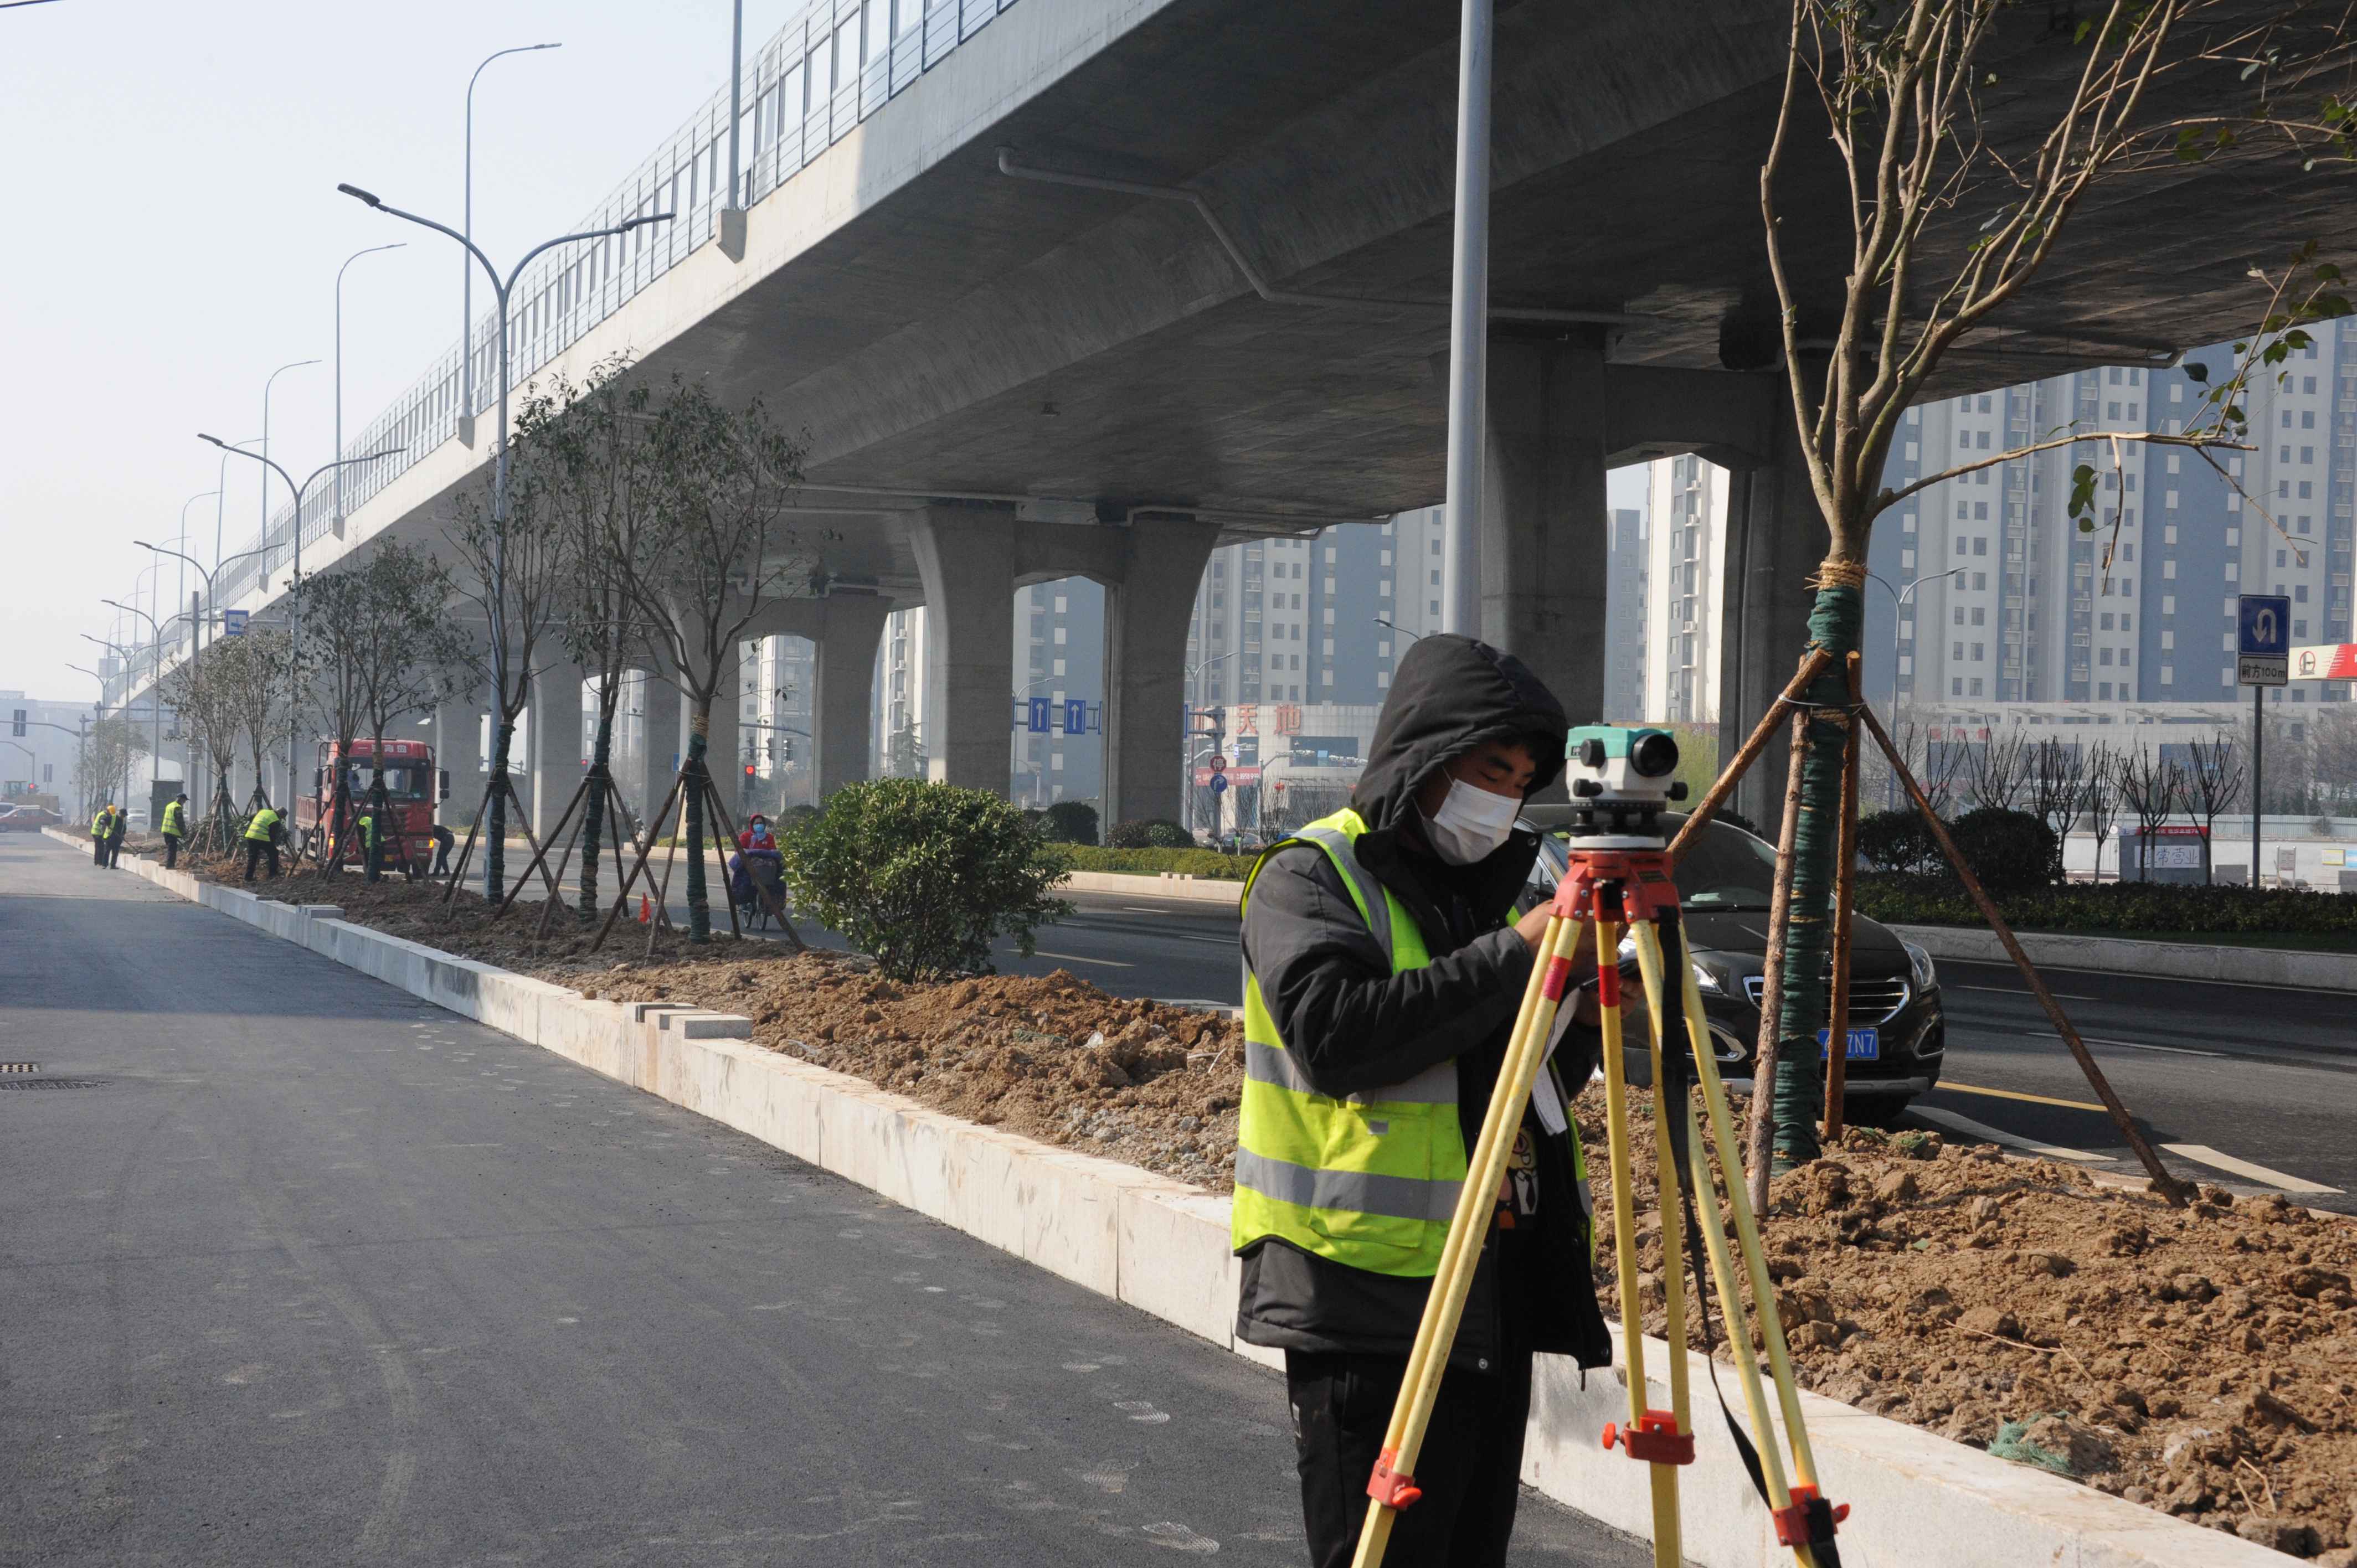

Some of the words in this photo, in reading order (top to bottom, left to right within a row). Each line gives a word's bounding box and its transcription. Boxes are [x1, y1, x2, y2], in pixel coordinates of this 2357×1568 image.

[2241, 664, 2286, 678] 前方100m
[1213, 757, 1224, 771] 停
[2144, 847, 2200, 866] 正常营业
